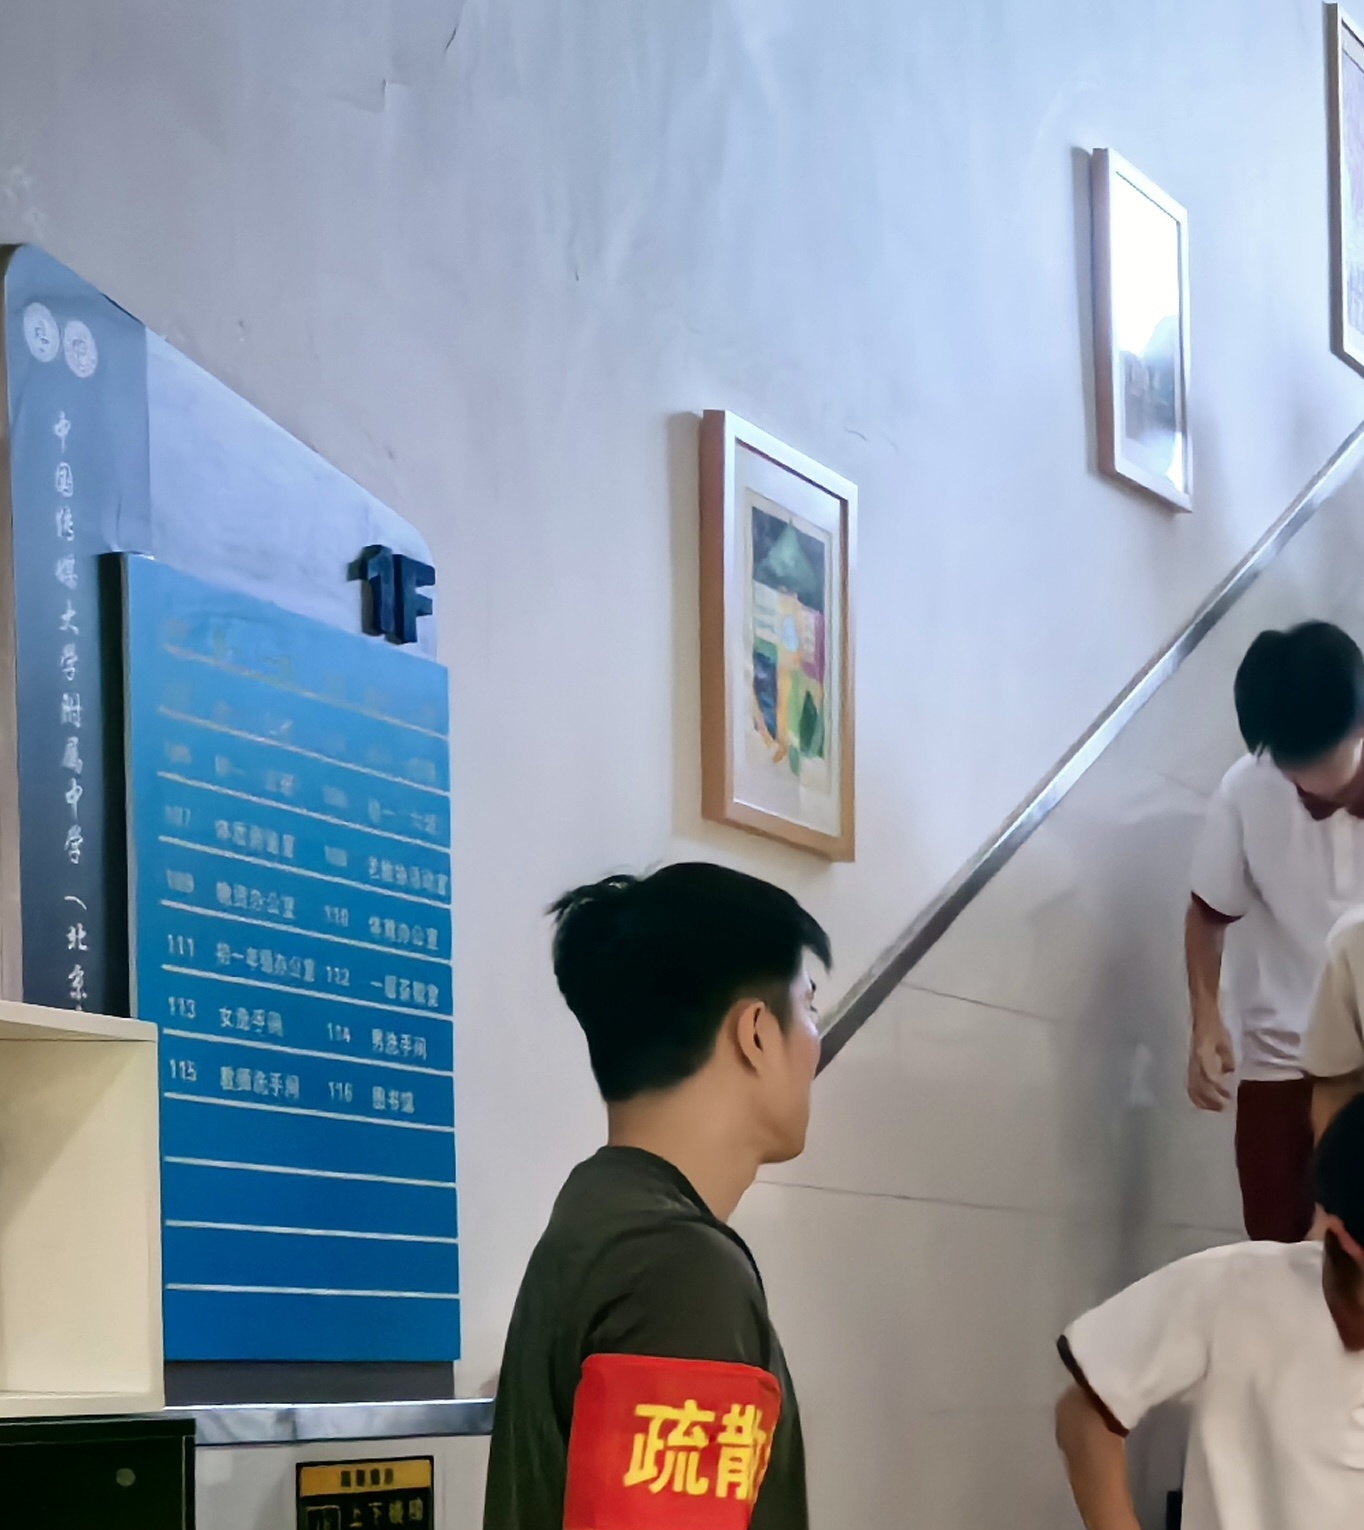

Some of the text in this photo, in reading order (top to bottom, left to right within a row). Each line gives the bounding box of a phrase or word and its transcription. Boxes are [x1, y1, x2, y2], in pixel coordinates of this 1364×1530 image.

[347, 544, 436, 645] 1F
[168, 934, 194, 957] 111
[168, 996, 196, 1018] 113
[169, 1058, 197, 1081] 115
[624, 1399, 770, 1500] 疏散
